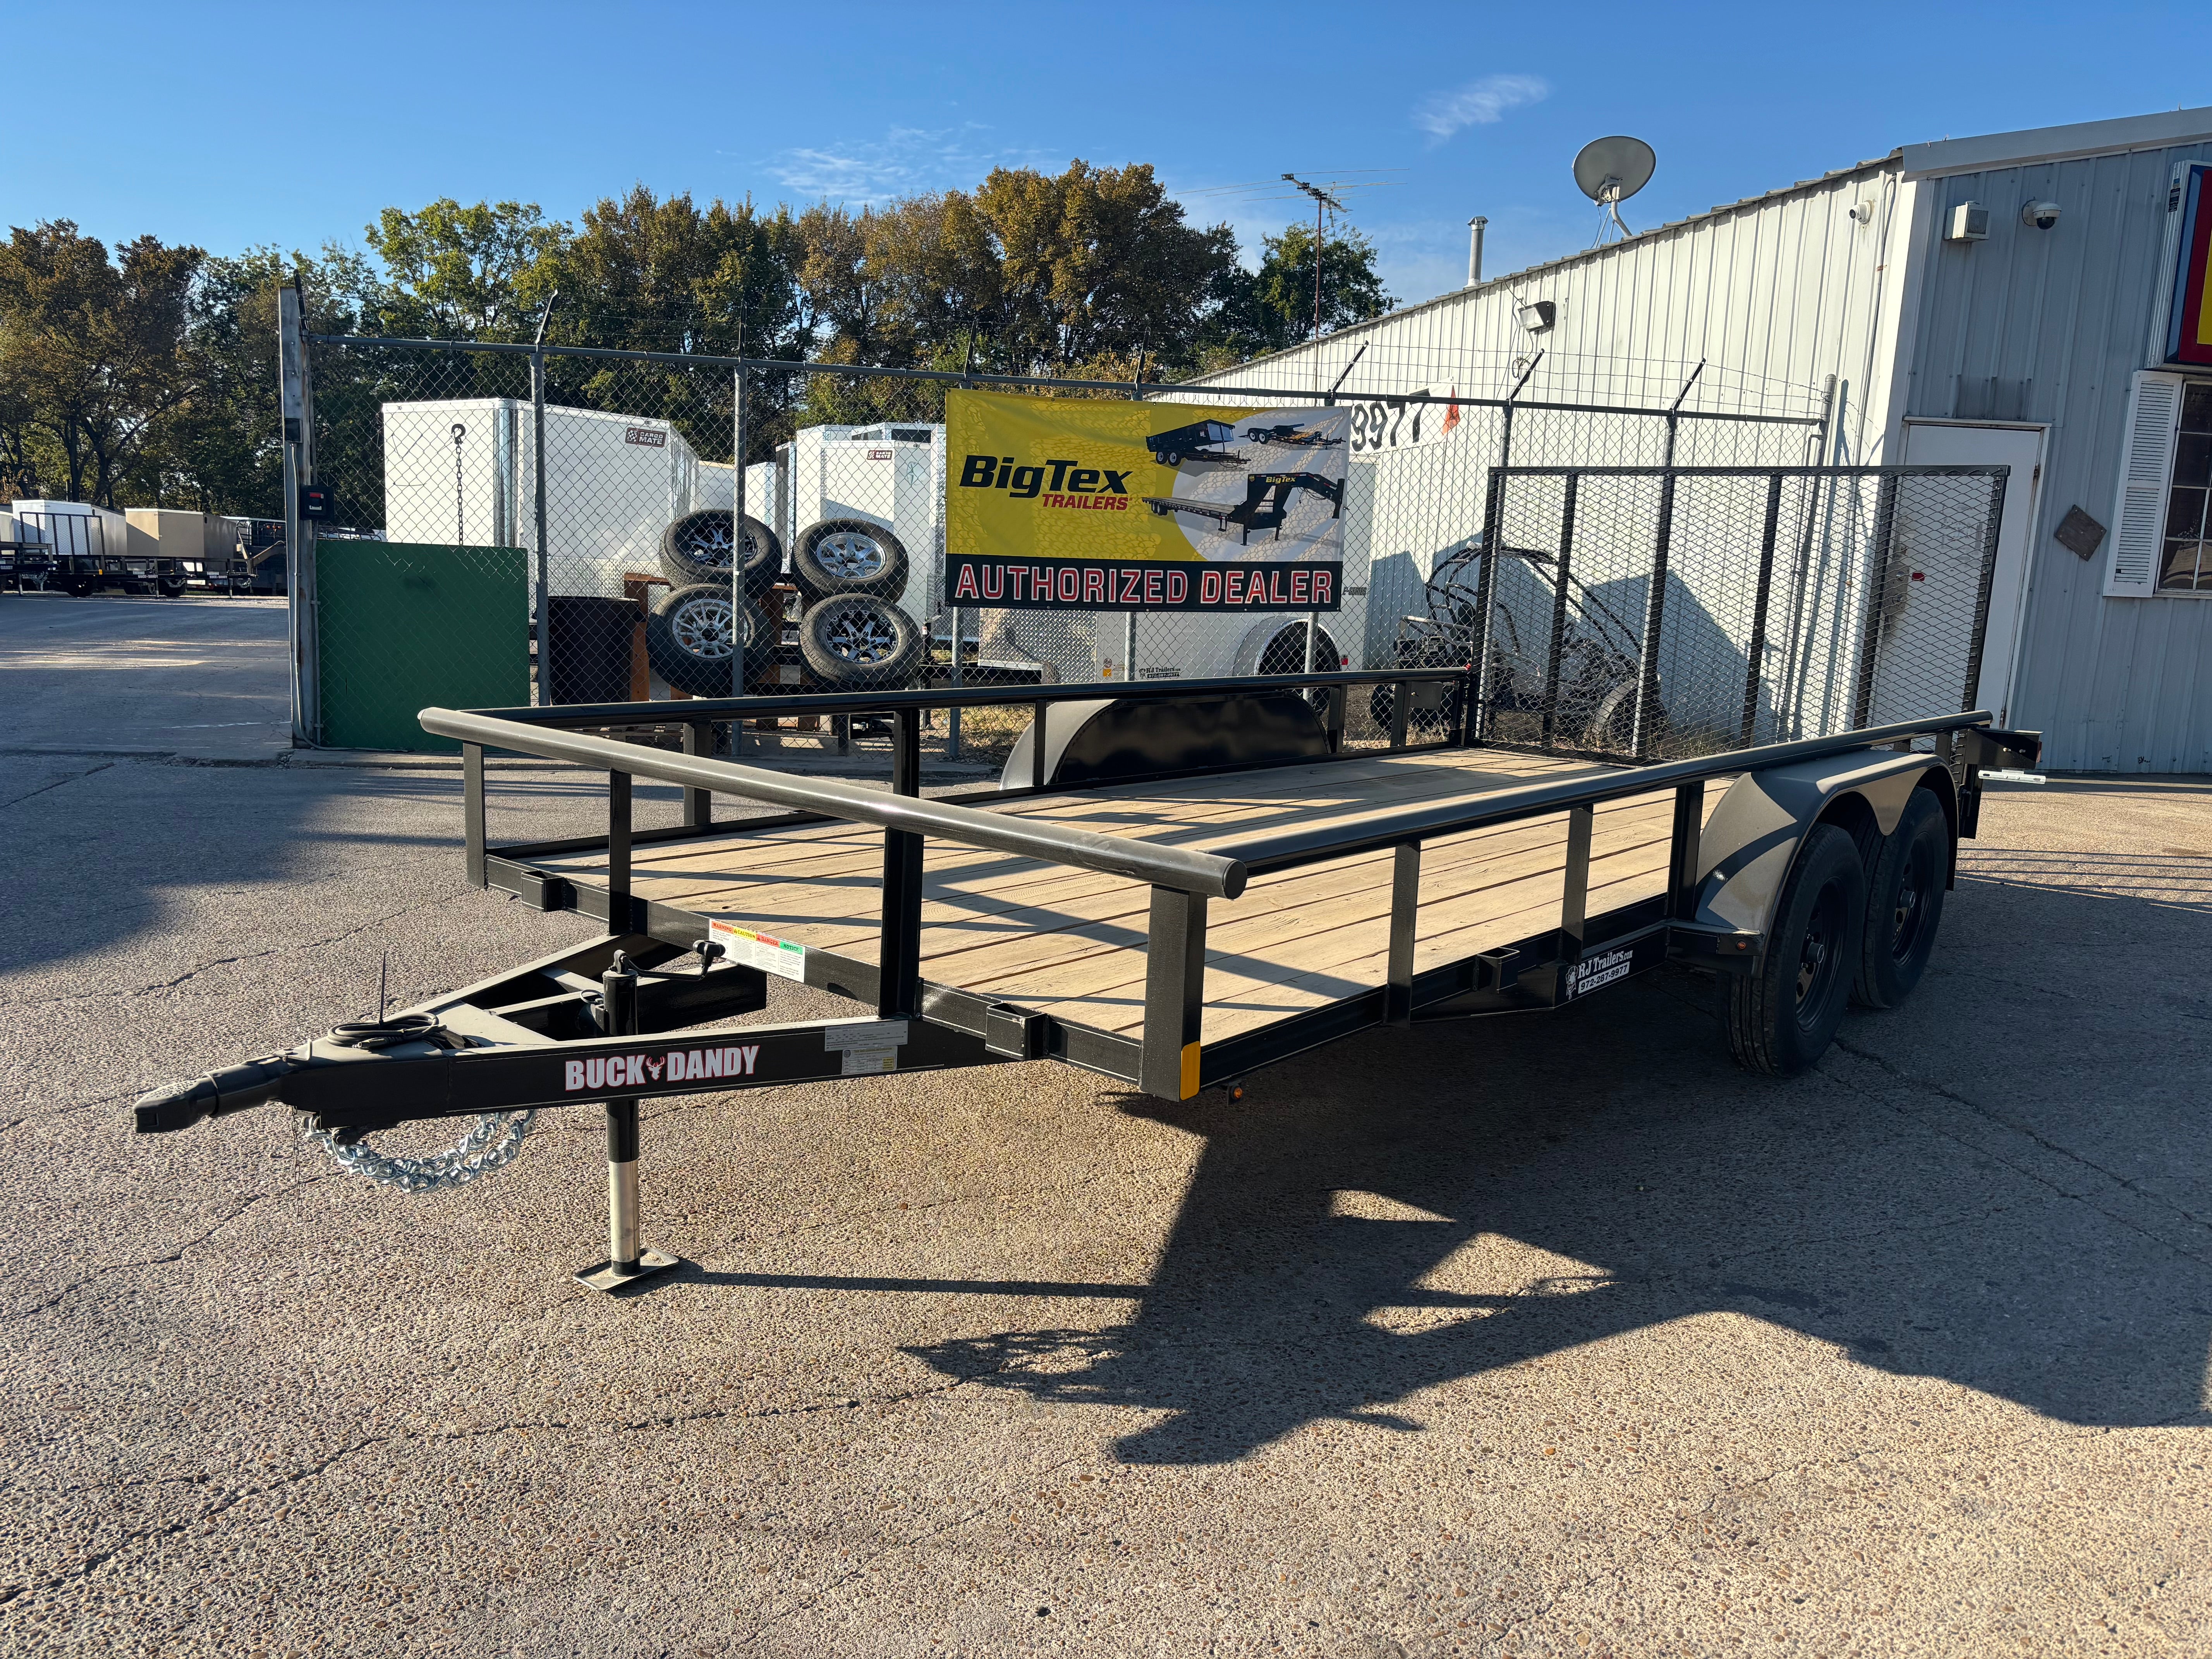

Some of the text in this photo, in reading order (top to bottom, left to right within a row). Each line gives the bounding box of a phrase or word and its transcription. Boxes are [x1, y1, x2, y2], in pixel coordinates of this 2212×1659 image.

[1352, 388, 1431, 452] 9977
[639, 436, 662, 445] MATE
[1042, 494, 1128, 510] TRAILERS
[955, 563, 1332, 605] AUTHORIZED DEALER
[713, 922, 732, 932] WARNING
[737, 930, 756, 939] CAUTION
[761, 936, 778, 946] DANGER
[783, 943, 799, 952] NOTICE
[1577, 959, 1592, 979] RJ
[1581, 964, 1628, 990] 972-287-9977
[565, 1045, 760, 1091] BUCK DANDY
